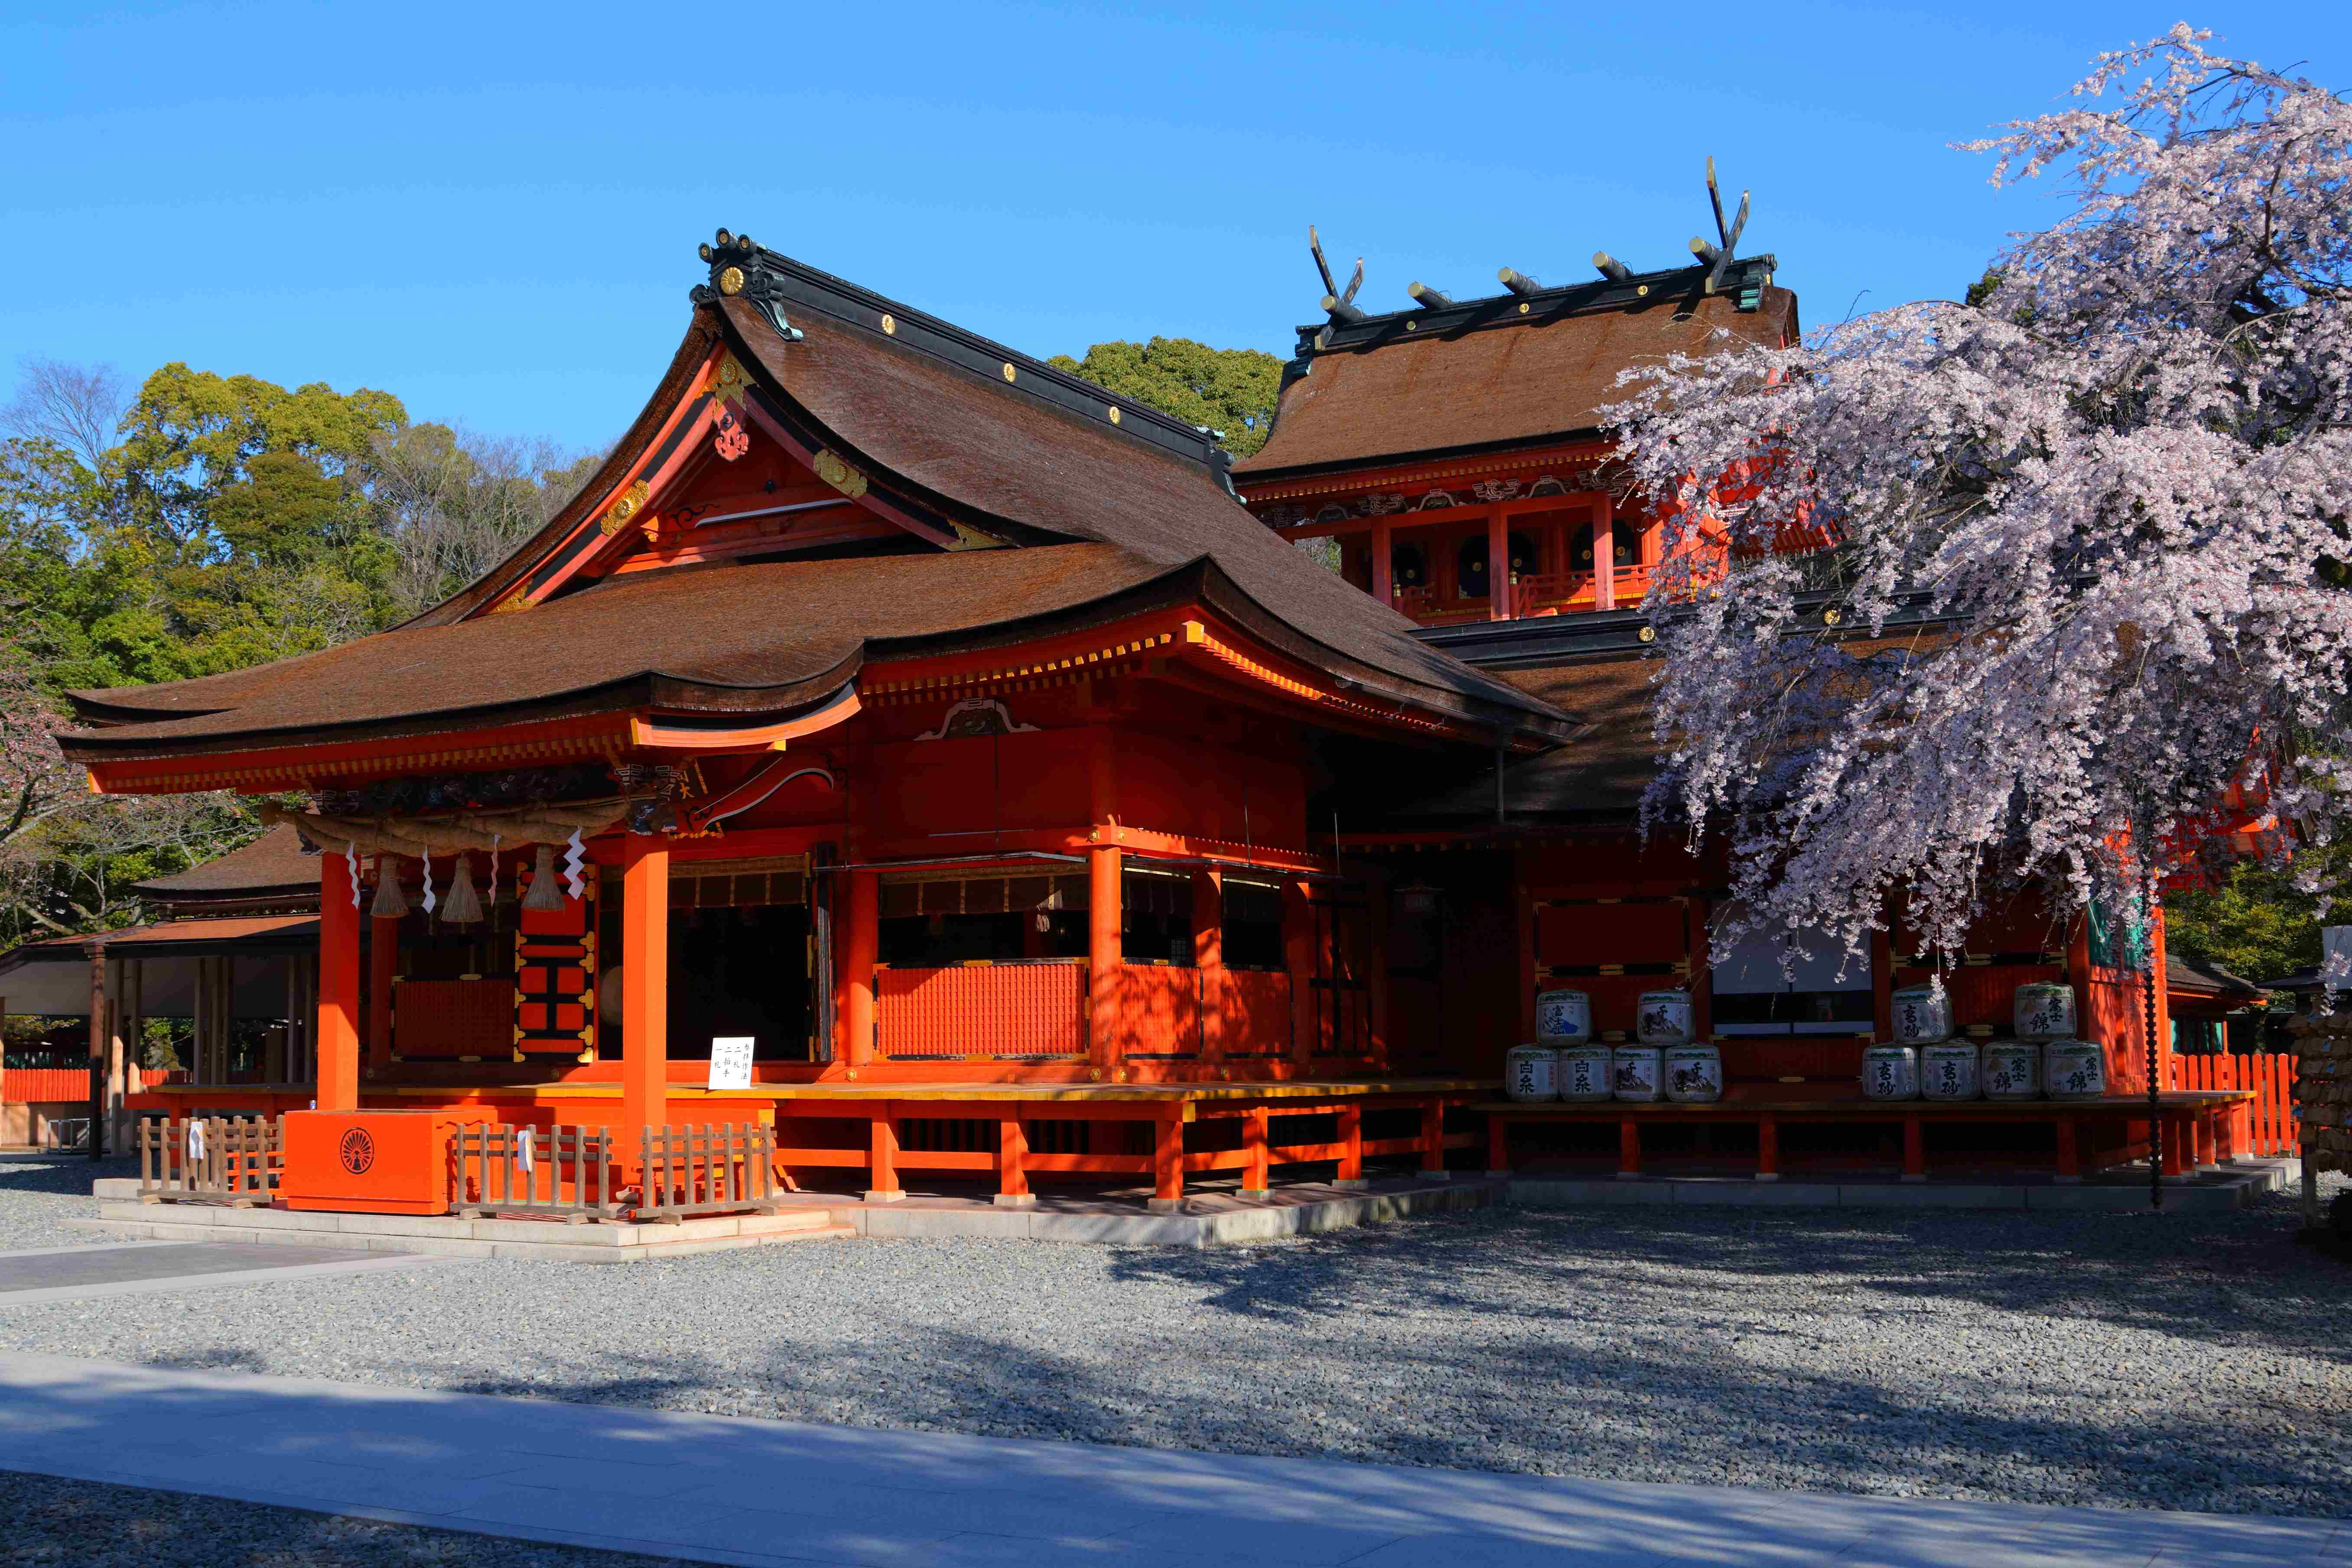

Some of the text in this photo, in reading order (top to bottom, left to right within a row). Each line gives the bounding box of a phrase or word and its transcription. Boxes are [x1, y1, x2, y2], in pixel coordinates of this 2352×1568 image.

[1553, 1005, 1565, 1035] 富士山
[1903, 1005, 1922, 1038] 高砂
[714, 1048, 722, 1068] 一礼
[723, 1047, 732, 1077] 二拍手
[733, 1047, 742, 1068] 二礼
[741, 1044, 750, 1080] 参拝作法
[1519, 1060, 1535, 1094] 白糸
[1575, 1060, 1591, 1093] 白糸
[1877, 1061, 1896, 1095] 高砂
[1942, 1061, 1961, 1095] 高砂
